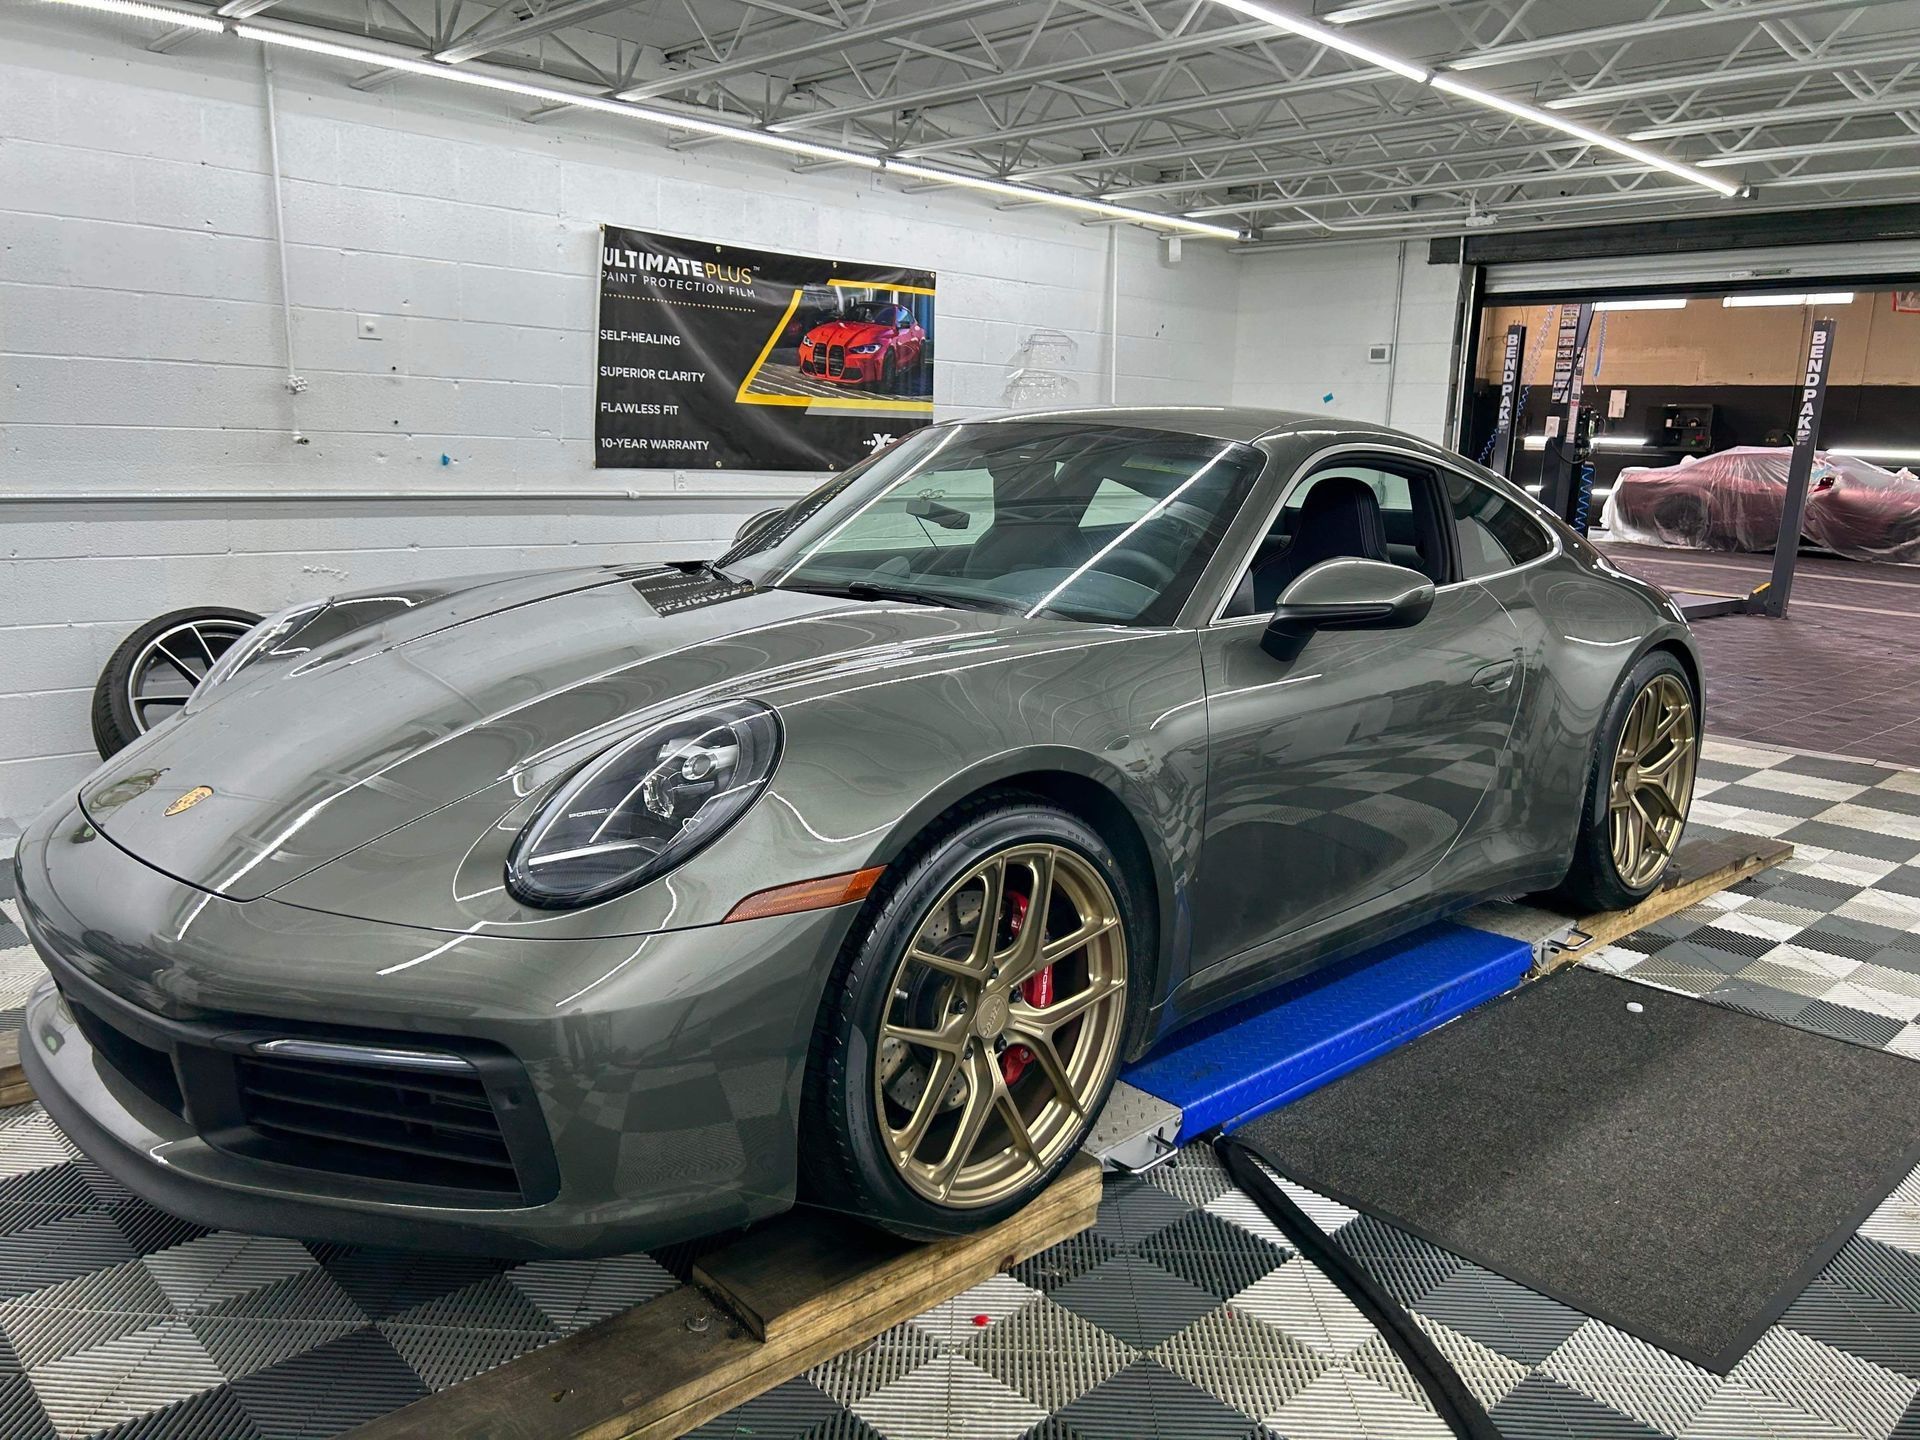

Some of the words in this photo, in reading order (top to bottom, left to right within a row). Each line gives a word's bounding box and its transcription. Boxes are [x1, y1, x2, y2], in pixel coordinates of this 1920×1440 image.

[601, 270, 637, 284] PAINT
[643, 275, 724, 295] PROTECTION
[728, 286, 756, 298] FILM
[600, 329, 681, 346] SELF-HEALING
[600, 366, 656, 379] SUPERIOR
[658, 370, 706, 382] CLARITY
[1498, 334, 1519, 420] BENDPAK
[1797, 331, 1828, 429] BENDPAK
[601, 402, 661, 415] FLAWLESS
[663, 405, 679, 415] FIT
[601, 438, 648, 449] 10-YEAR
[650, 439, 710, 451] WARRANTY
